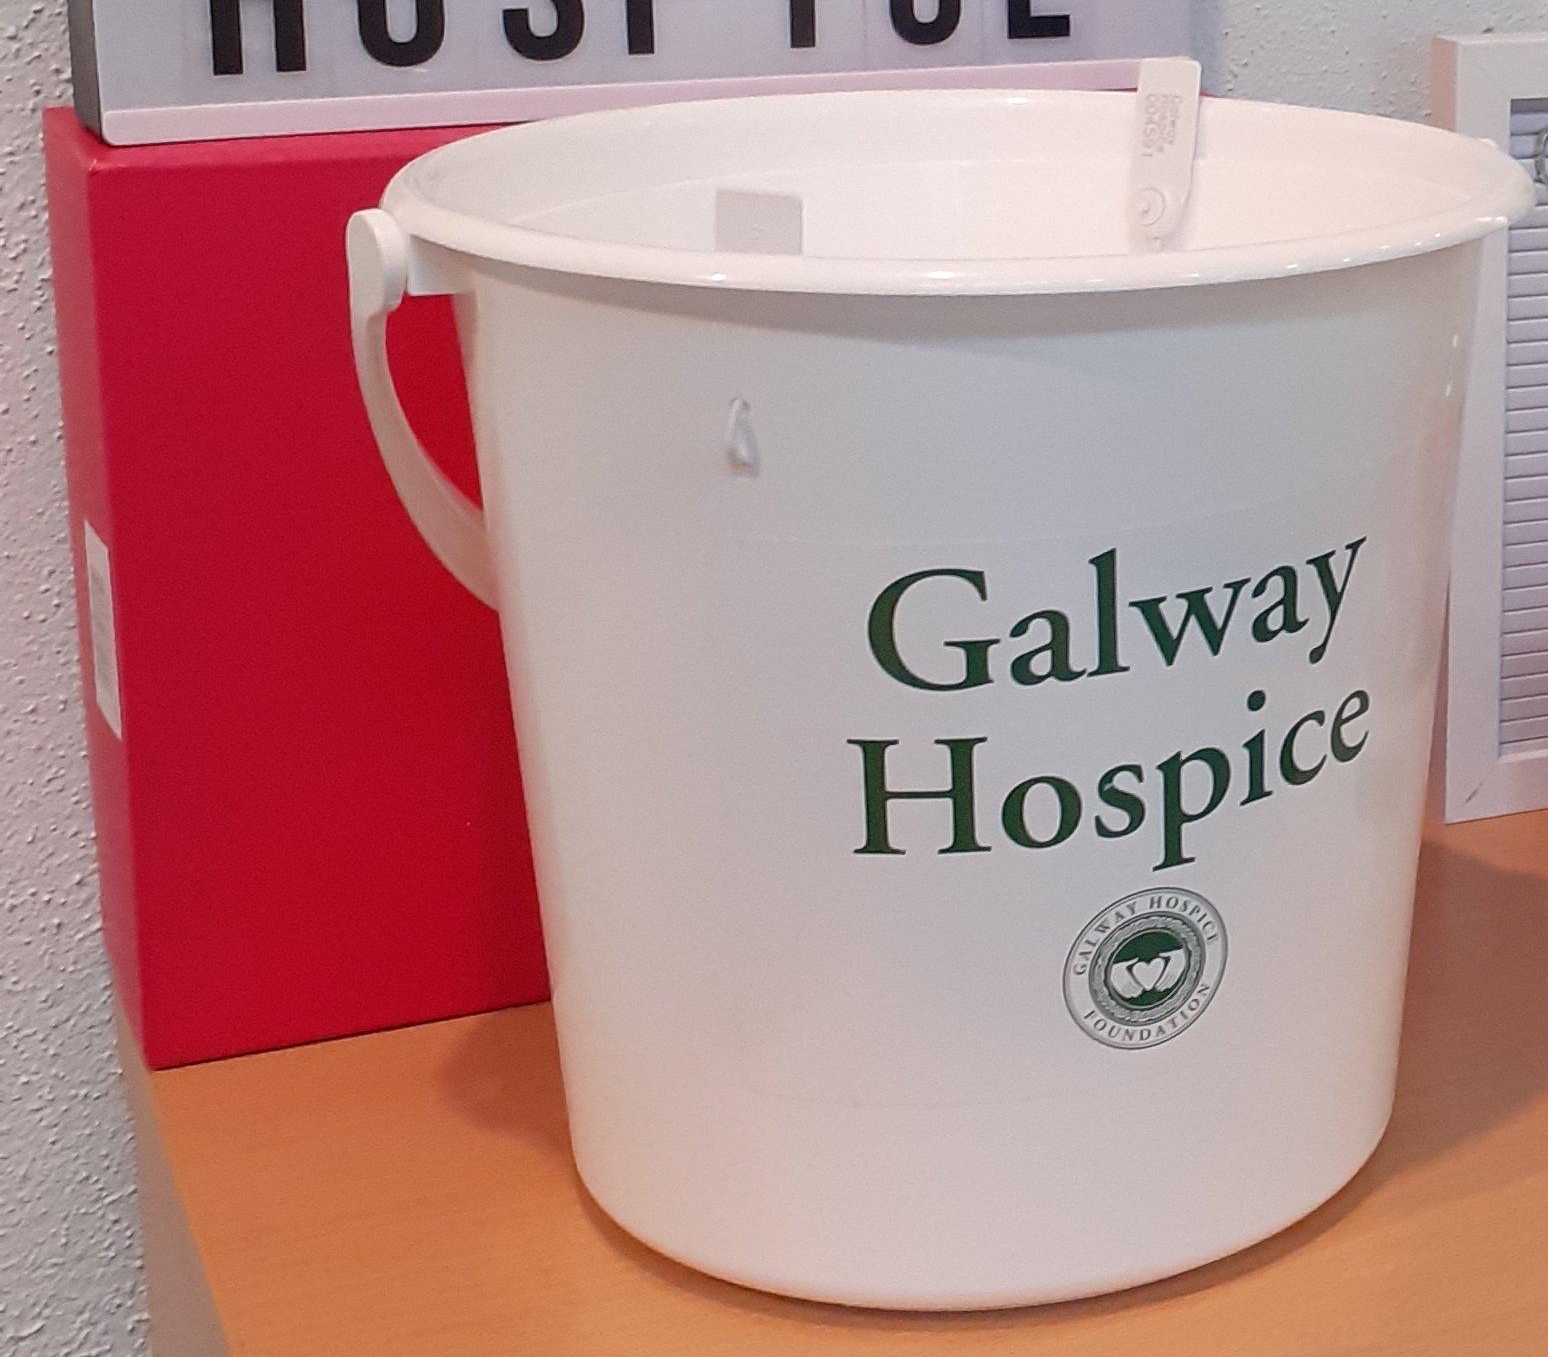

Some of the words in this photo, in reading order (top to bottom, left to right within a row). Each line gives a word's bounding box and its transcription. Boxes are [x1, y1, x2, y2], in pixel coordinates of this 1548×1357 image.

[866, 535, 1368, 692] Galway
[846, 689, 1371, 872] Hospice
[1072, 900, 1138, 976] GALWAY
[1149, 894, 1219, 943] HOSPICE
[1083, 983, 1211, 1042] FOUNDATION
